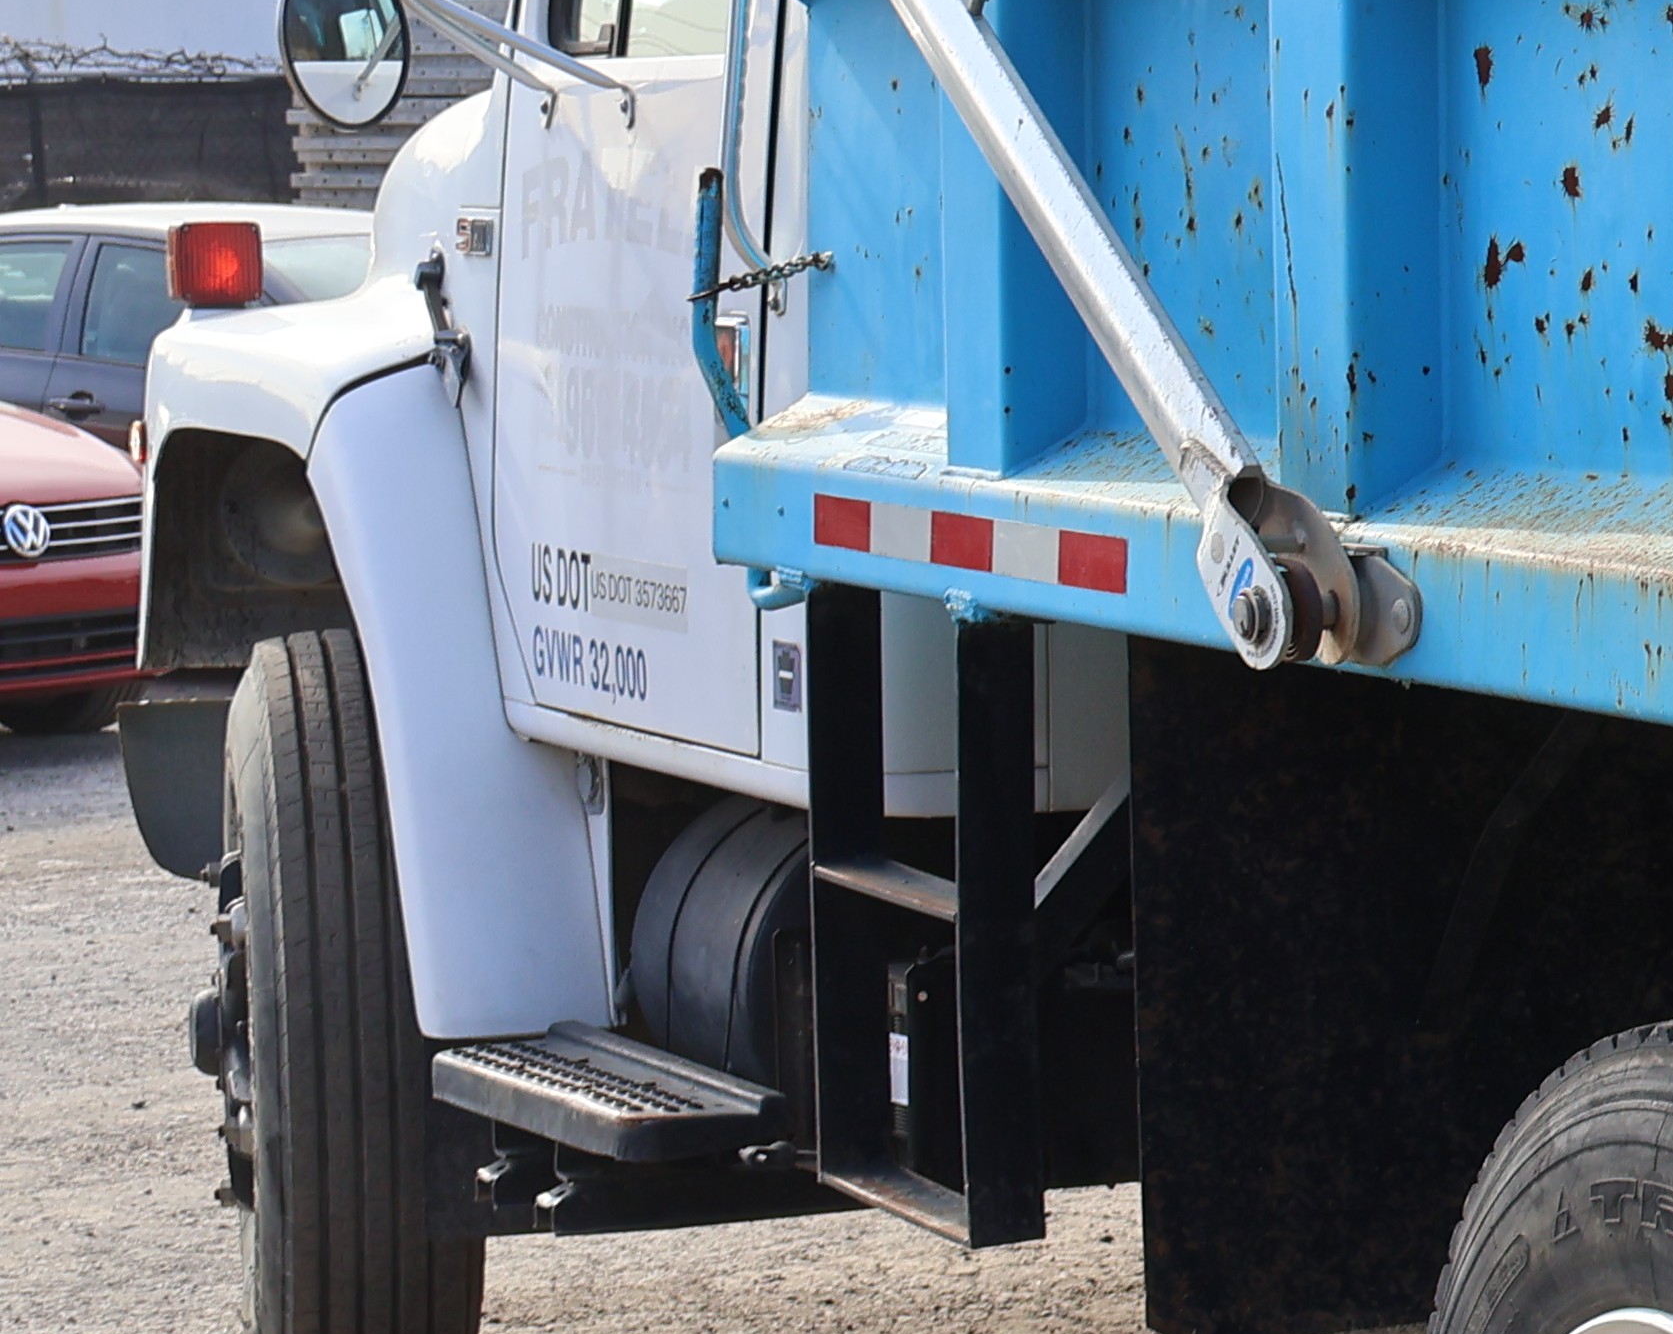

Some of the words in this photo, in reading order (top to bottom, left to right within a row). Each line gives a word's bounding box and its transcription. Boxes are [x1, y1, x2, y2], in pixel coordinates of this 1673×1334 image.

[531, 542, 553, 605] US
[557, 548, 591, 612] DOT
[591, 570, 606, 599] US
[608, 574, 633, 604] DOT
[635, 578, 688, 615] 3573667
[533, 625, 585, 686] GVWR
[589, 638, 648, 705] 32,000
